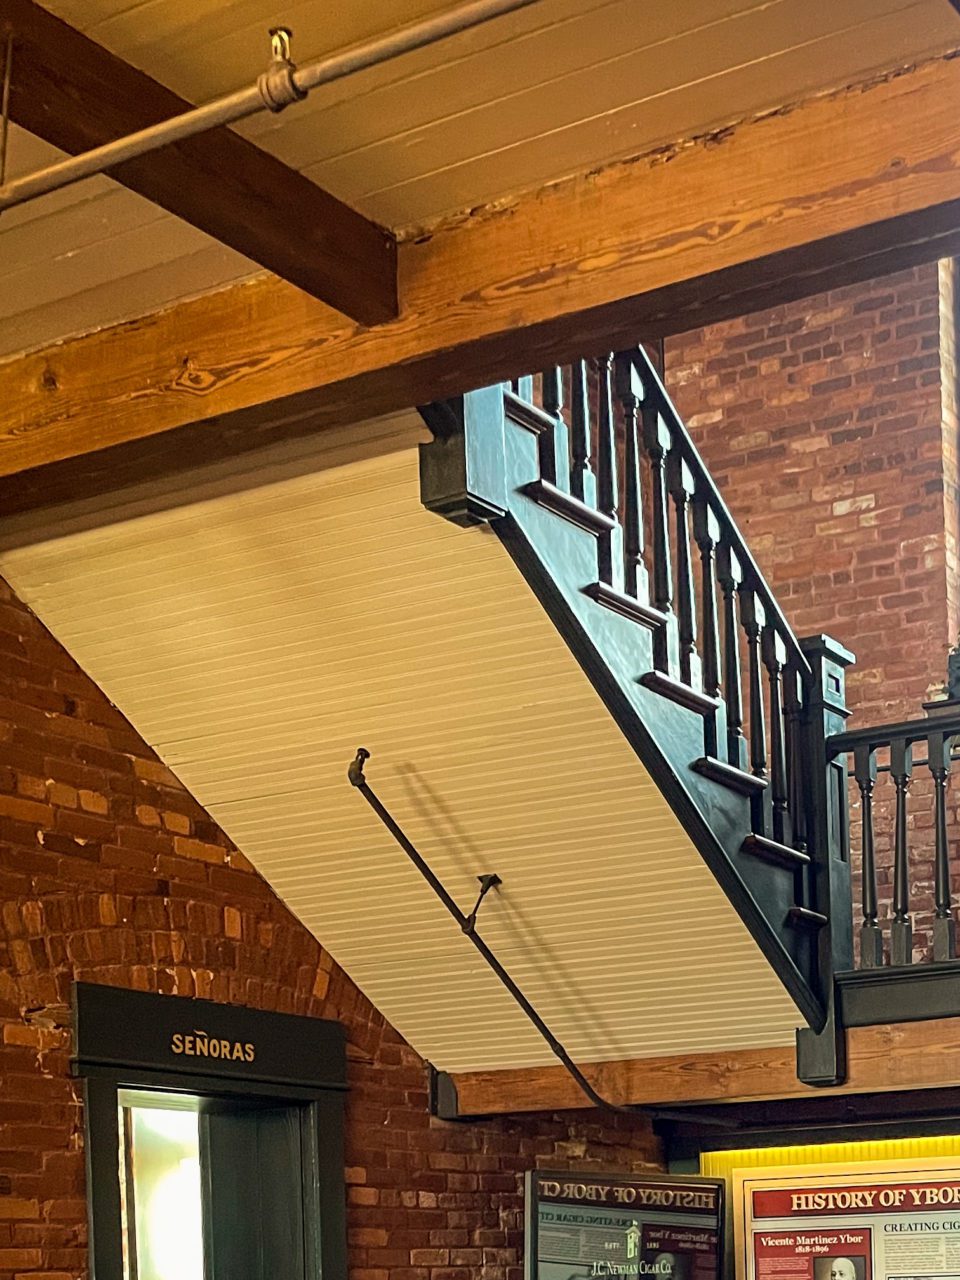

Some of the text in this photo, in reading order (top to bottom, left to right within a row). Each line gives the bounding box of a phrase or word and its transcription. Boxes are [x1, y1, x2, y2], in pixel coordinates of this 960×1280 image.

[171, 1029, 255, 1062] SEÑORAS
[790, 1190, 878, 1211] HISTORY
[879, 1189, 907, 1207] OF
[883, 1222, 940, 1233] CREATING
[760, 1233, 864, 1247] Vicente Martinez Ybor
